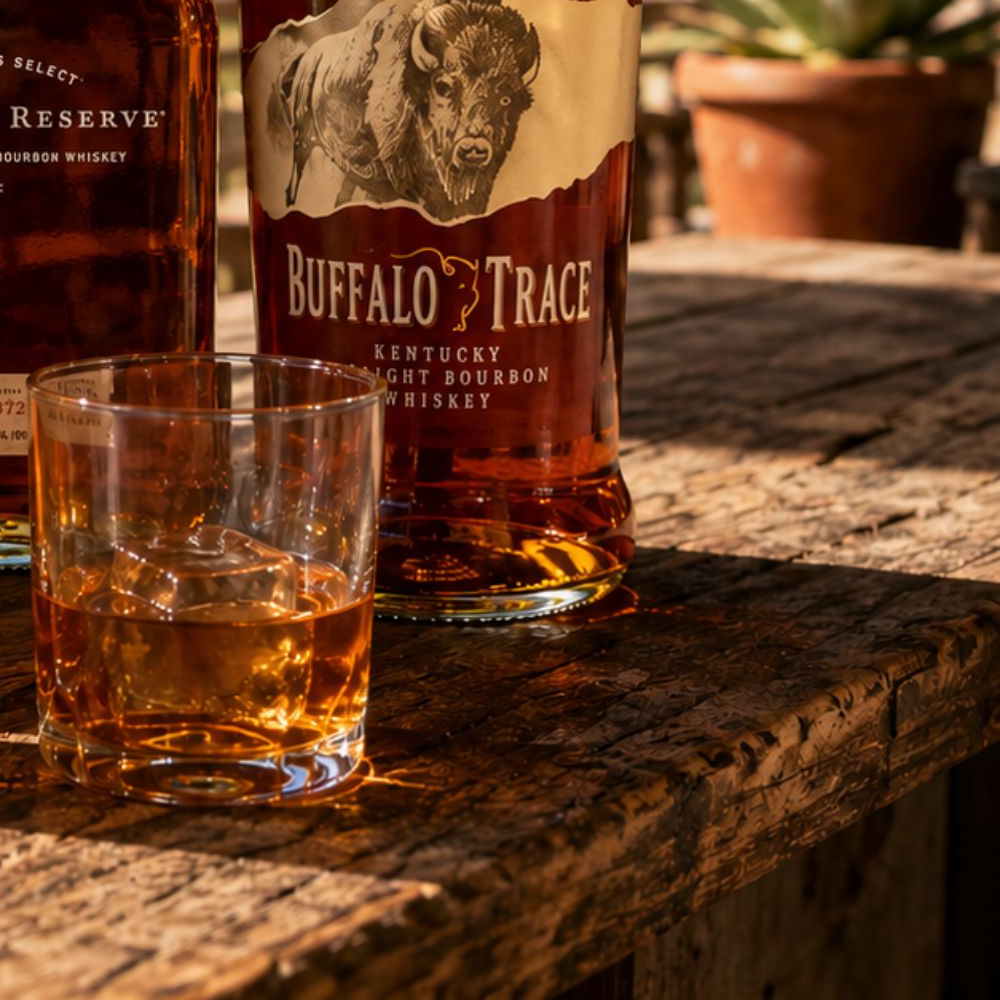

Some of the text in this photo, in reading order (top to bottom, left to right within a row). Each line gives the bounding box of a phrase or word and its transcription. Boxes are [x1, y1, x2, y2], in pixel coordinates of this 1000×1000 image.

[13, 56, 79, 86] SELECT
[9, 106, 159, 129] RESERVE
[65, 151, 127, 163] WHISKEY
[287, 244, 593, 332] BUFFALO TRACE
[374, 344, 500, 363] KENTUCKY
[444, 367, 549, 386] BOURBON
[385, 391, 490, 409] WHISKEY
